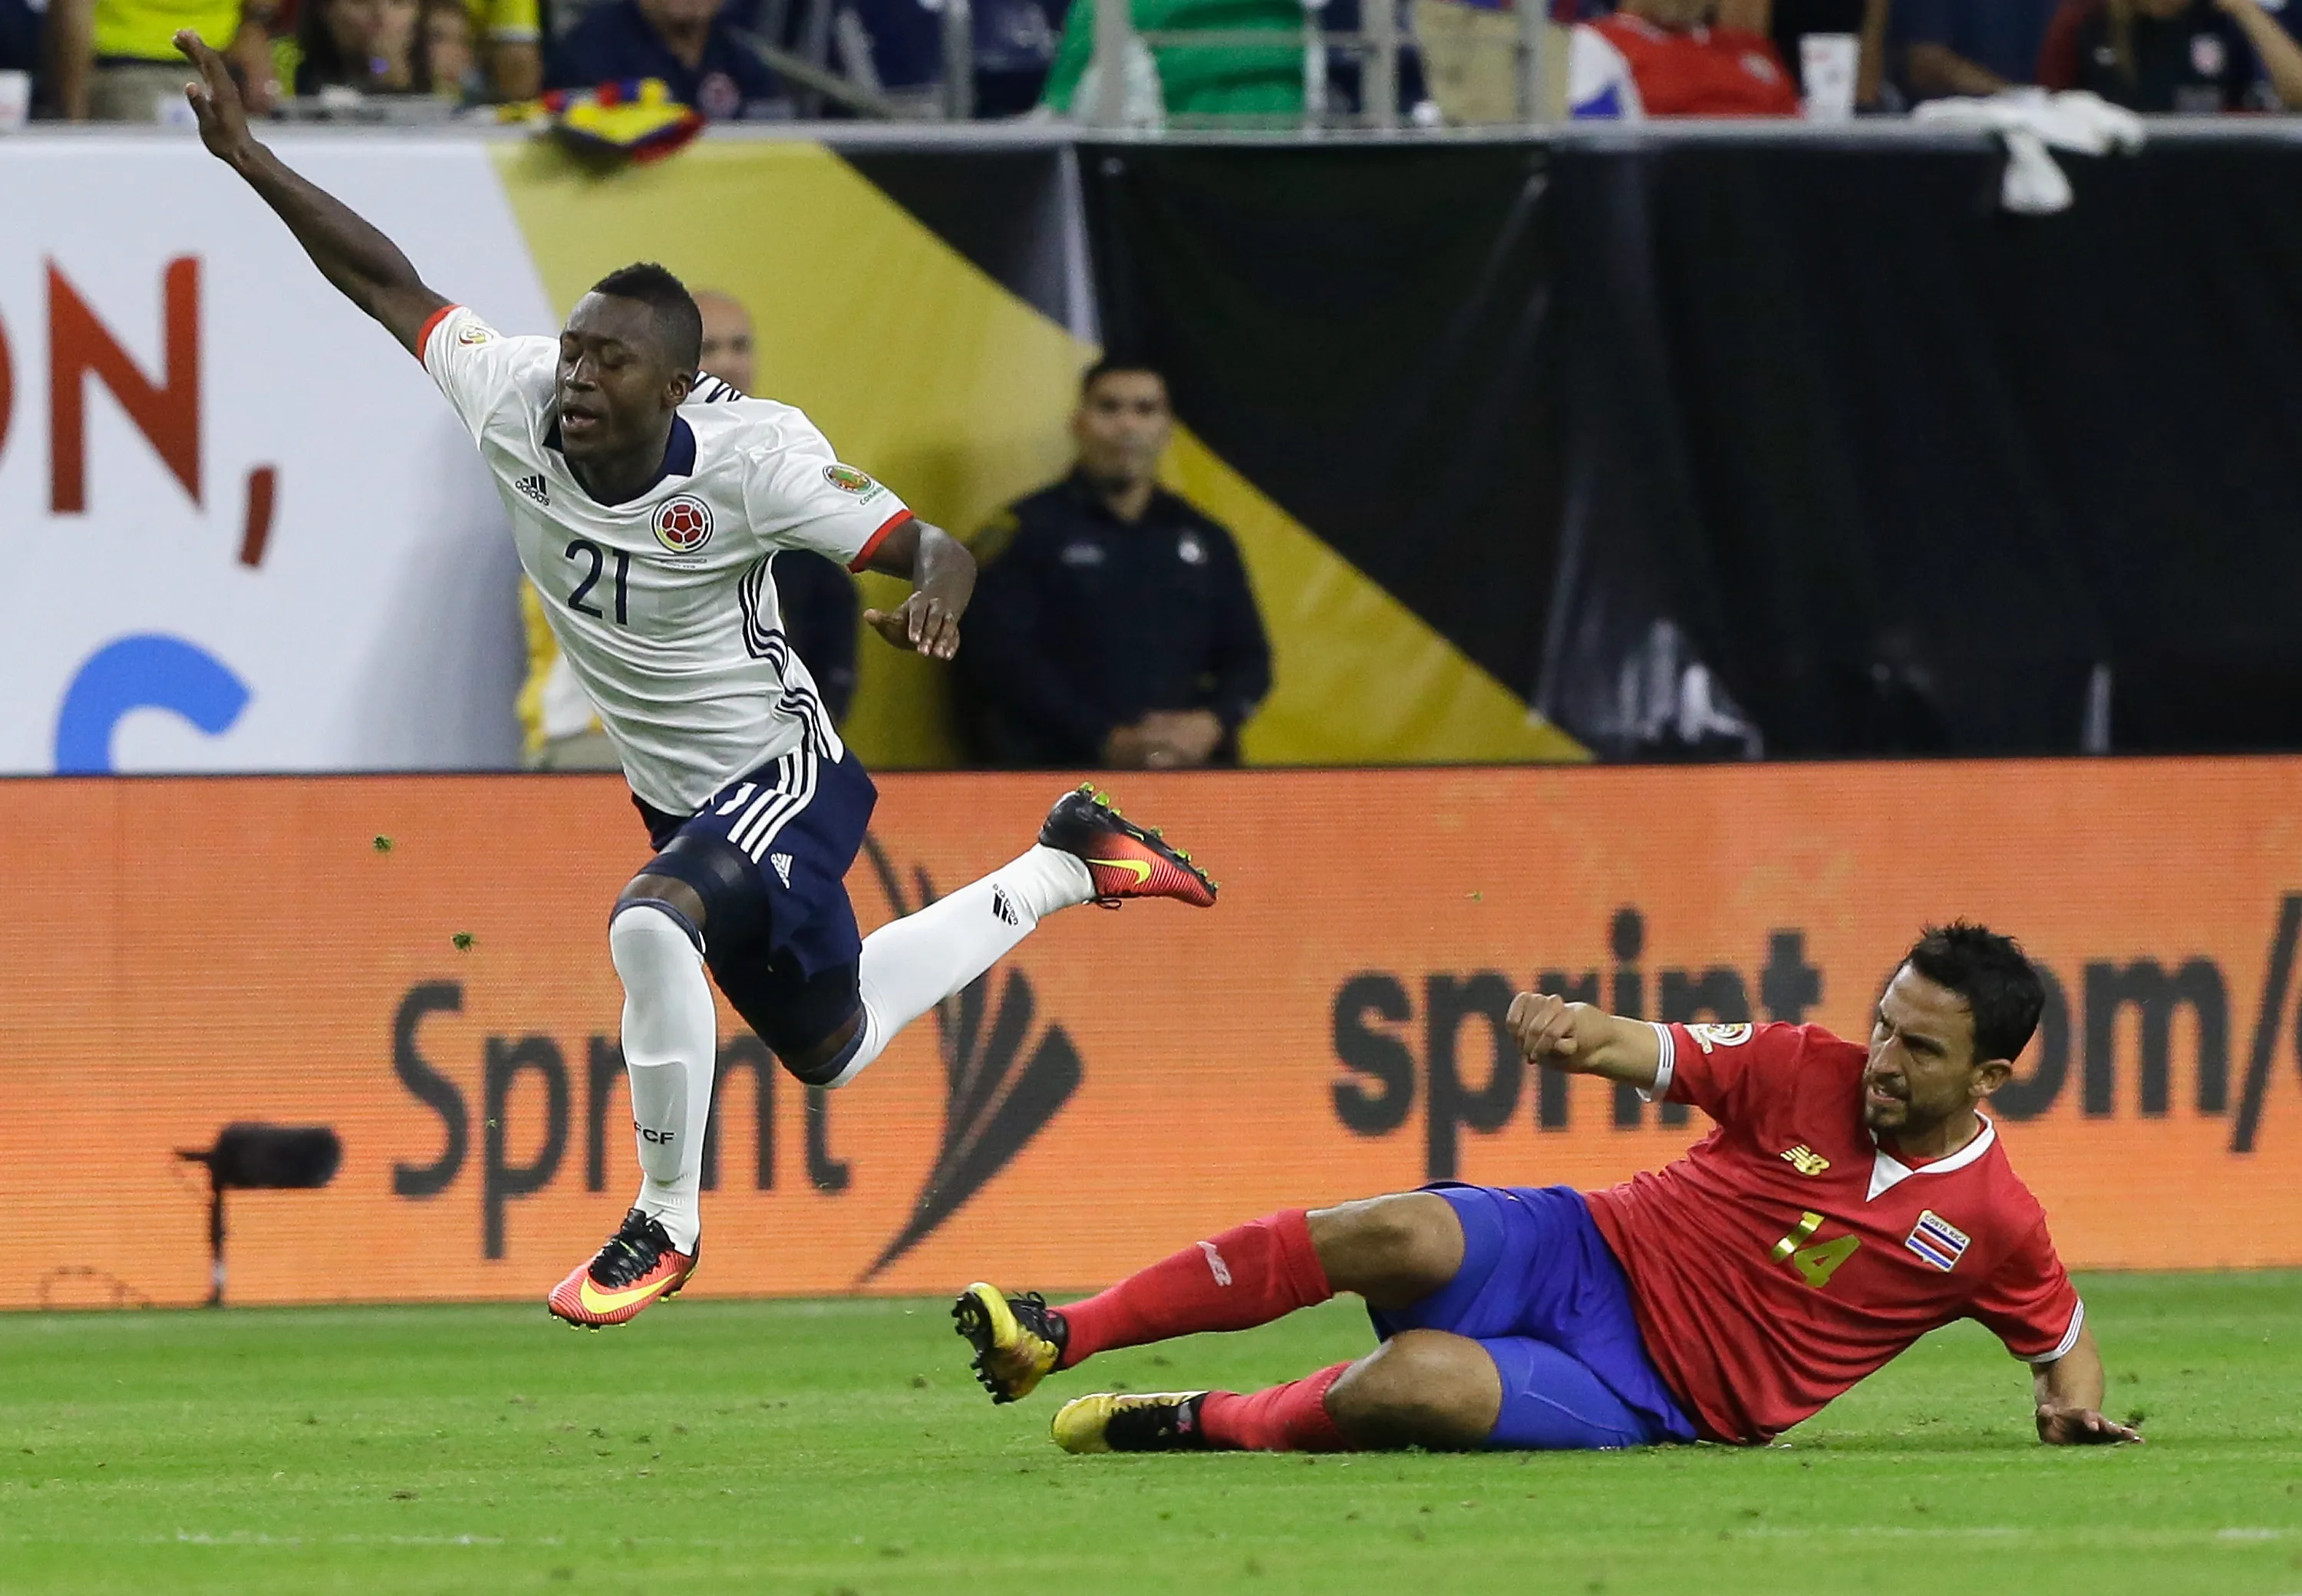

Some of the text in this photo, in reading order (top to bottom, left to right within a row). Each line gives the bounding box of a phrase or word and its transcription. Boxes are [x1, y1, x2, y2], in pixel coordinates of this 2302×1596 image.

[0, 255, 278, 569] N,
[515, 480, 550, 506] adidas
[565, 539, 629, 625] 21
[394, 980, 850, 1260] Sprnt
[1770, 1211, 1862, 1289] 14
[1924, 1215, 1967, 1245] COSTA RICA
